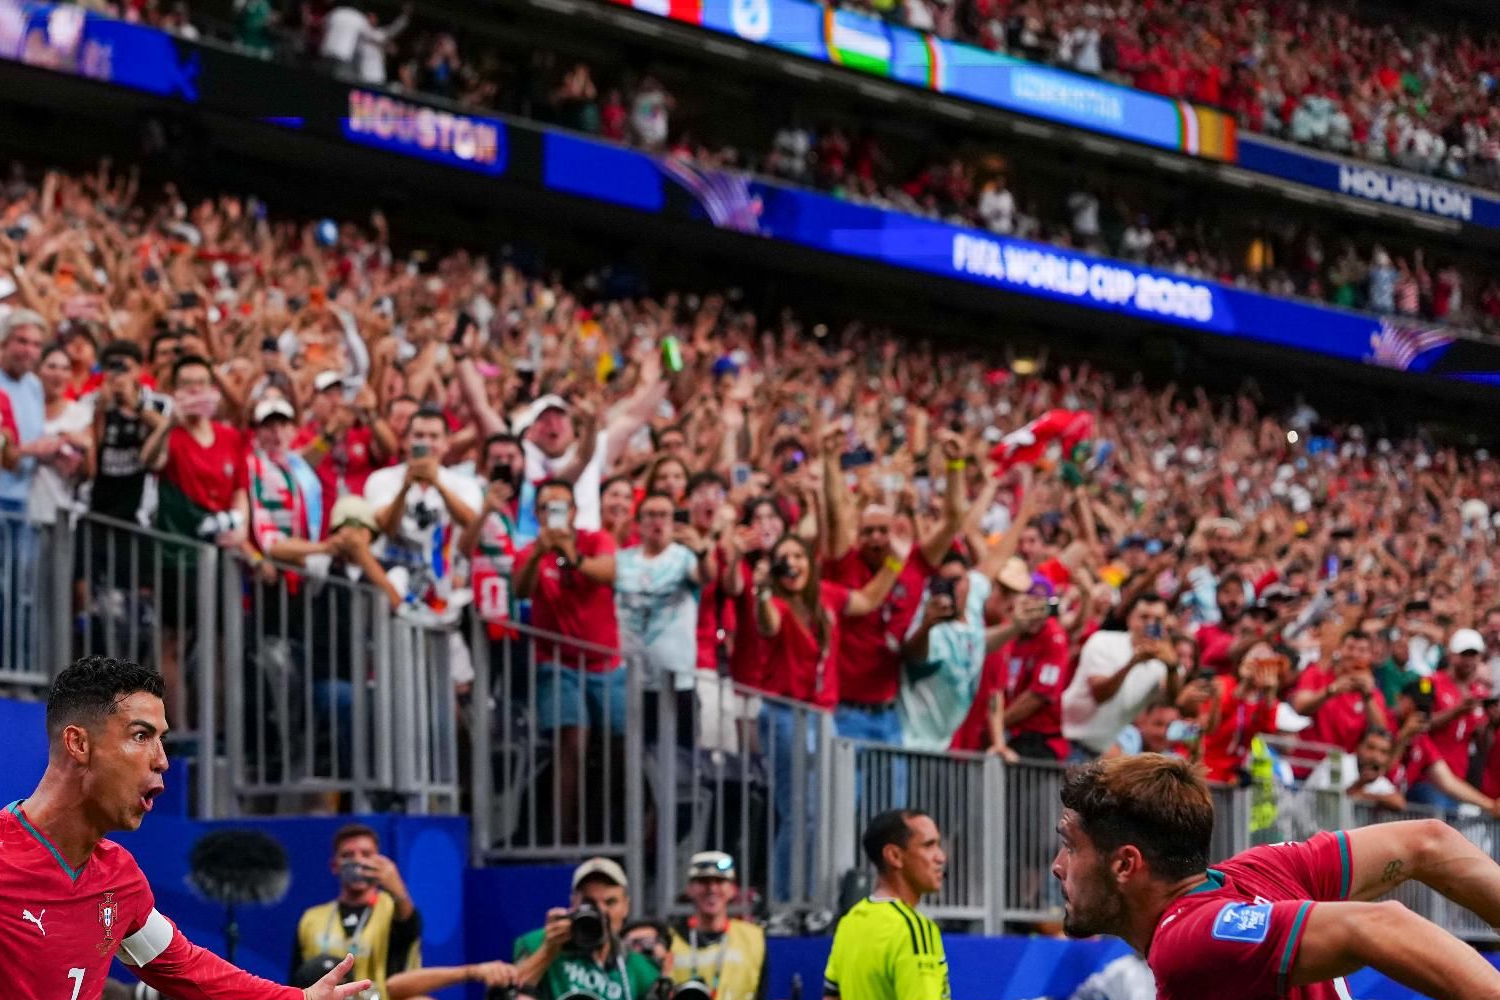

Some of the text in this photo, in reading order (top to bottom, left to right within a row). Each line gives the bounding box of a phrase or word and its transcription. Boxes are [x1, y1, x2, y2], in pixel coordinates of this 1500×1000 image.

[348, 90, 498, 165] HOUSTON
[1339, 164, 1473, 221] HOUSTON
[953, 233, 1213, 322] FIFA WORLD CUP 2026
